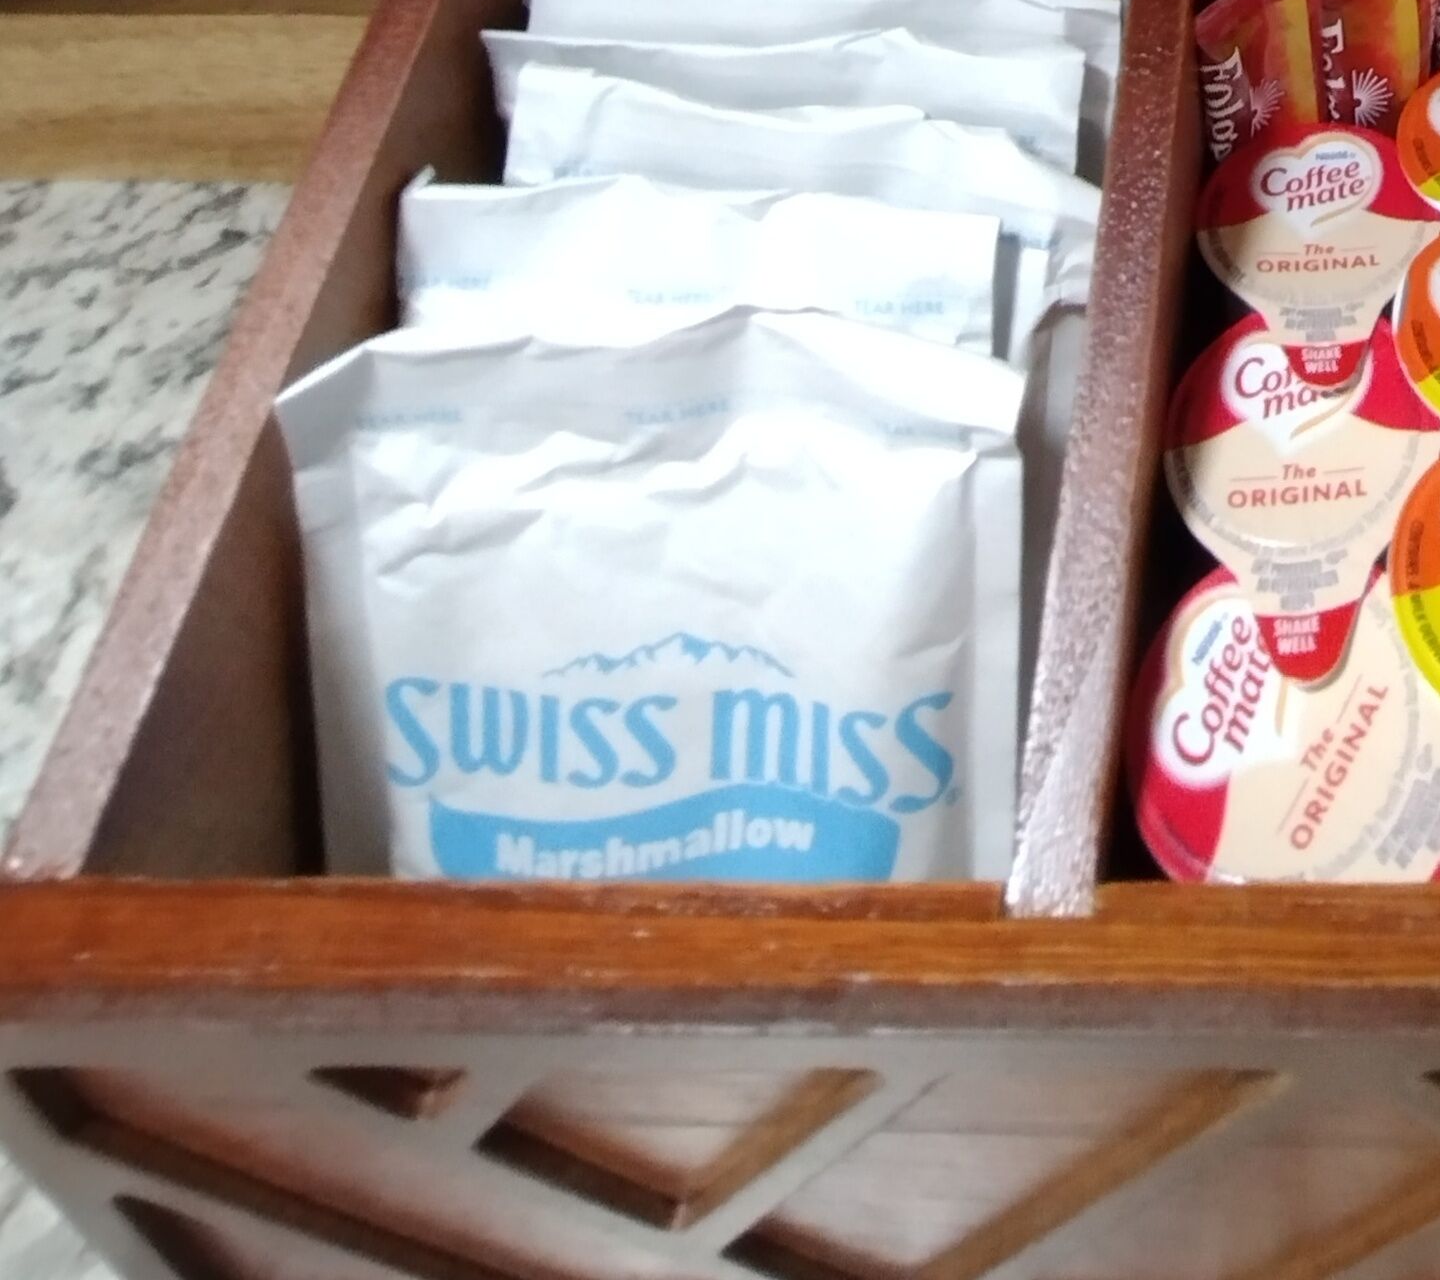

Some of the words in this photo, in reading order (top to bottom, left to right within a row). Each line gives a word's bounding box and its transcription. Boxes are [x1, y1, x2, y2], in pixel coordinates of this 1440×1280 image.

[1260, 161, 1361, 197] Coffee
[1285, 178, 1366, 212] mate
[1256, 253, 1381, 274] ORIGINAL
[1303, 244, 1335, 256] The
[1282, 464, 1317, 480] The
[1227, 479, 1368, 509] ORIGINAL
[1273, 615, 1320, 638] SHAKE
[1276, 635, 1318, 656] WELL
[1172, 615, 1253, 766] Coffee
[1222, 645, 1274, 754] mat
[385, 676, 679, 788] SWISS
[710, 688, 955, 814] MISS
[1300, 728, 1336, 771] The
[1289, 684, 1389, 852] ORIGINAL
[495, 808, 816, 880] Marshmallow
